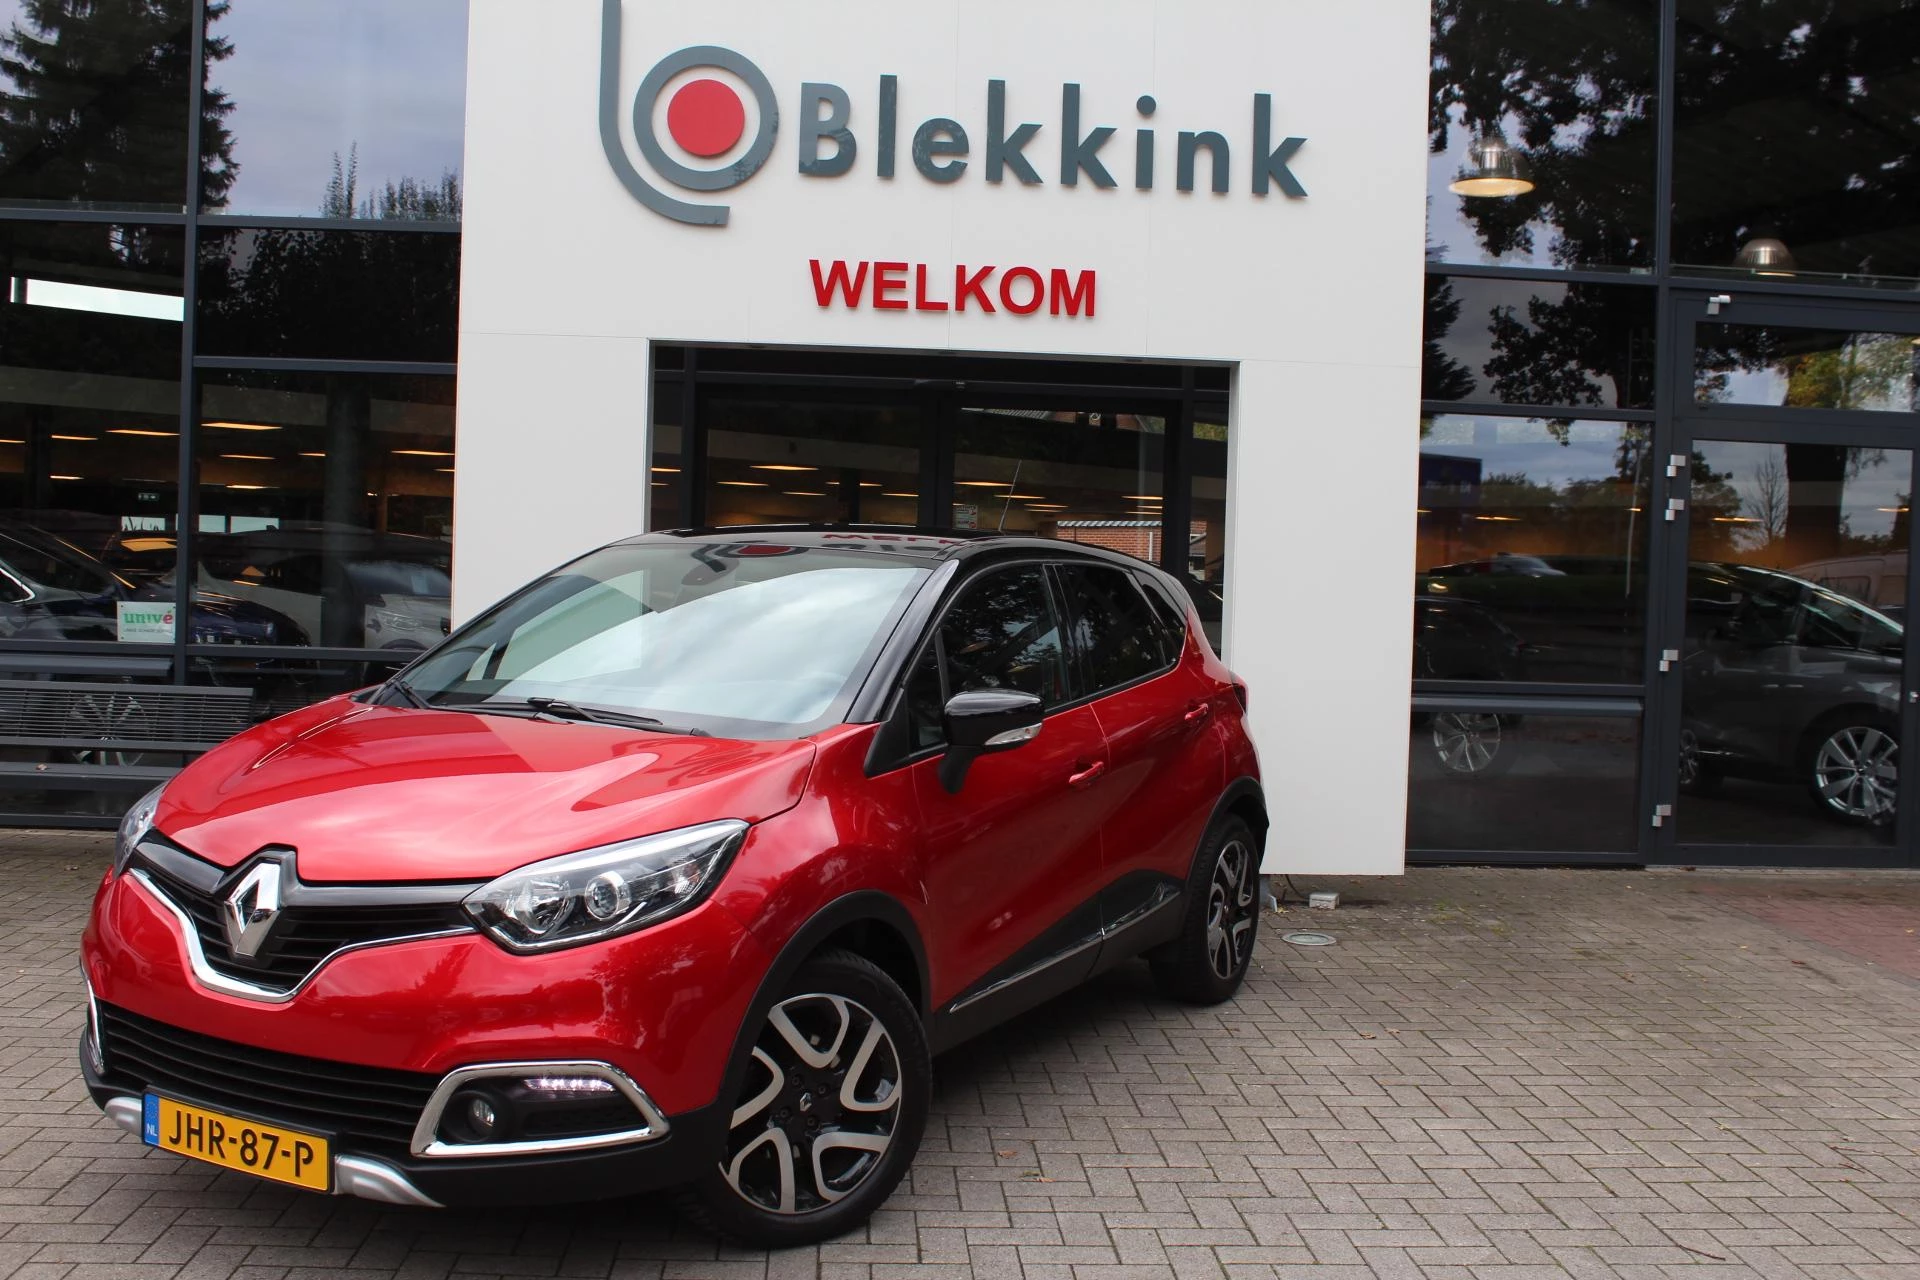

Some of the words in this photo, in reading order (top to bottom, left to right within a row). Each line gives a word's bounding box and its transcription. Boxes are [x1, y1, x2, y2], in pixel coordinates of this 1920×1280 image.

[799, 74, 1308, 198] Blekkink
[809, 259, 1097, 317] WELKOM
[146, 1123, 158, 1136] NL
[168, 1110, 314, 1178] JHR-87-P
